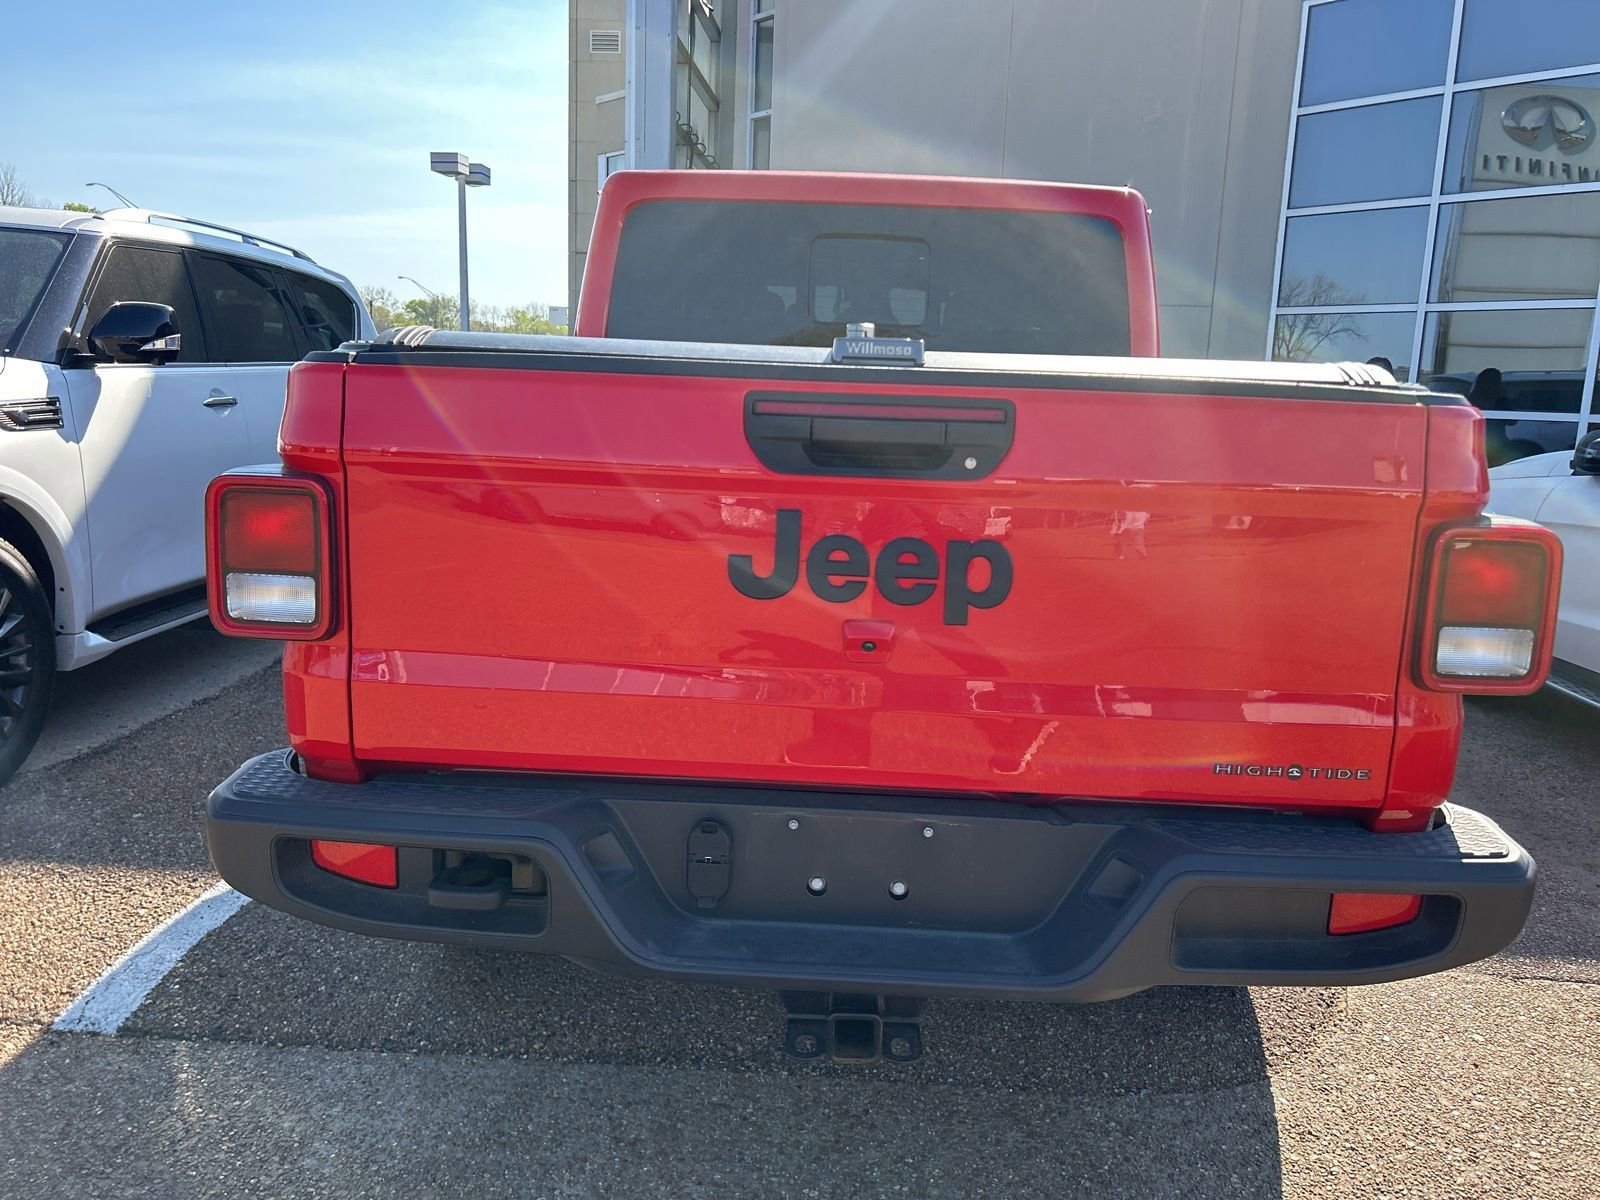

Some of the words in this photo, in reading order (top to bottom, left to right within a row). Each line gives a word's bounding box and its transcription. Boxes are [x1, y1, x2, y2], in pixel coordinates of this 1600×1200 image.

[727, 508, 1013, 625] Jeep
[1213, 763, 1284, 777] HIGH
[1307, 767, 1372, 780] TIDE
